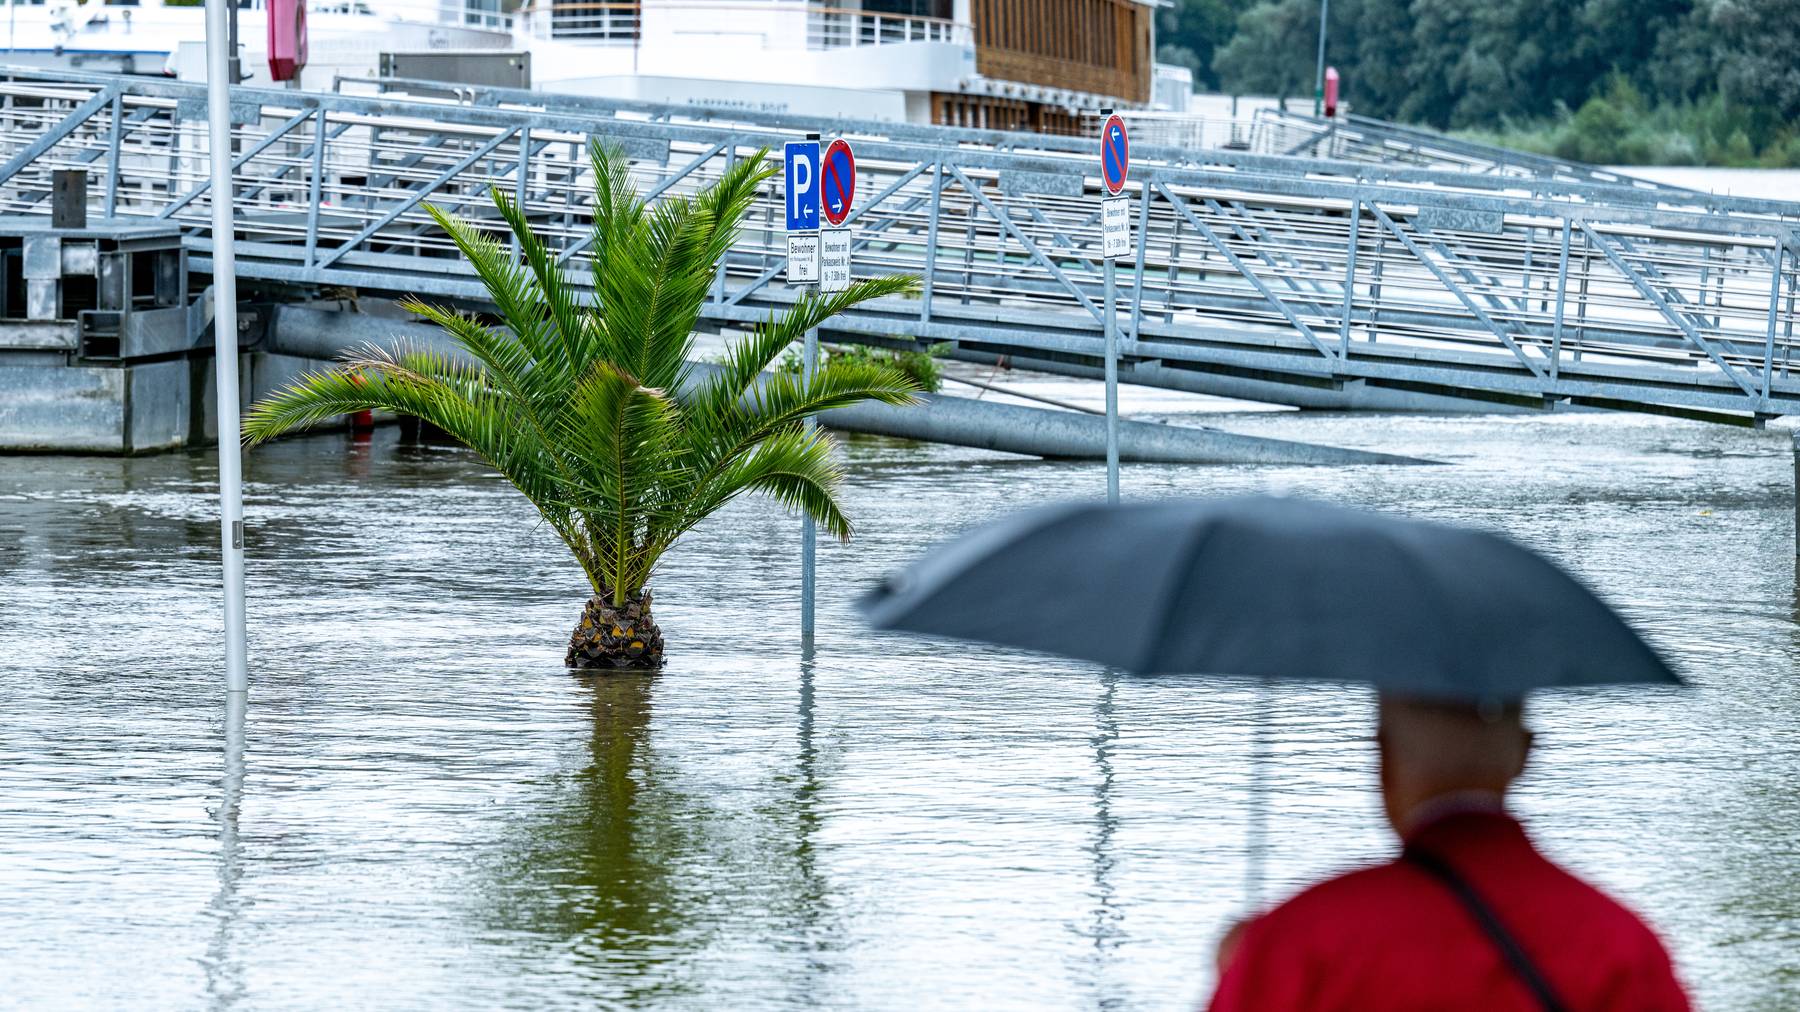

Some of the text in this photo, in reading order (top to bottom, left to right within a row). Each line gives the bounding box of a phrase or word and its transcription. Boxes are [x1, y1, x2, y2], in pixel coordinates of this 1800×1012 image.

[793, 154, 812, 219] P
[791, 242, 816, 254] Bewohner
[825, 241, 841, 252] Bewohner
[821, 256, 841, 267] Parkausweis
[799, 264, 808, 276] frei
